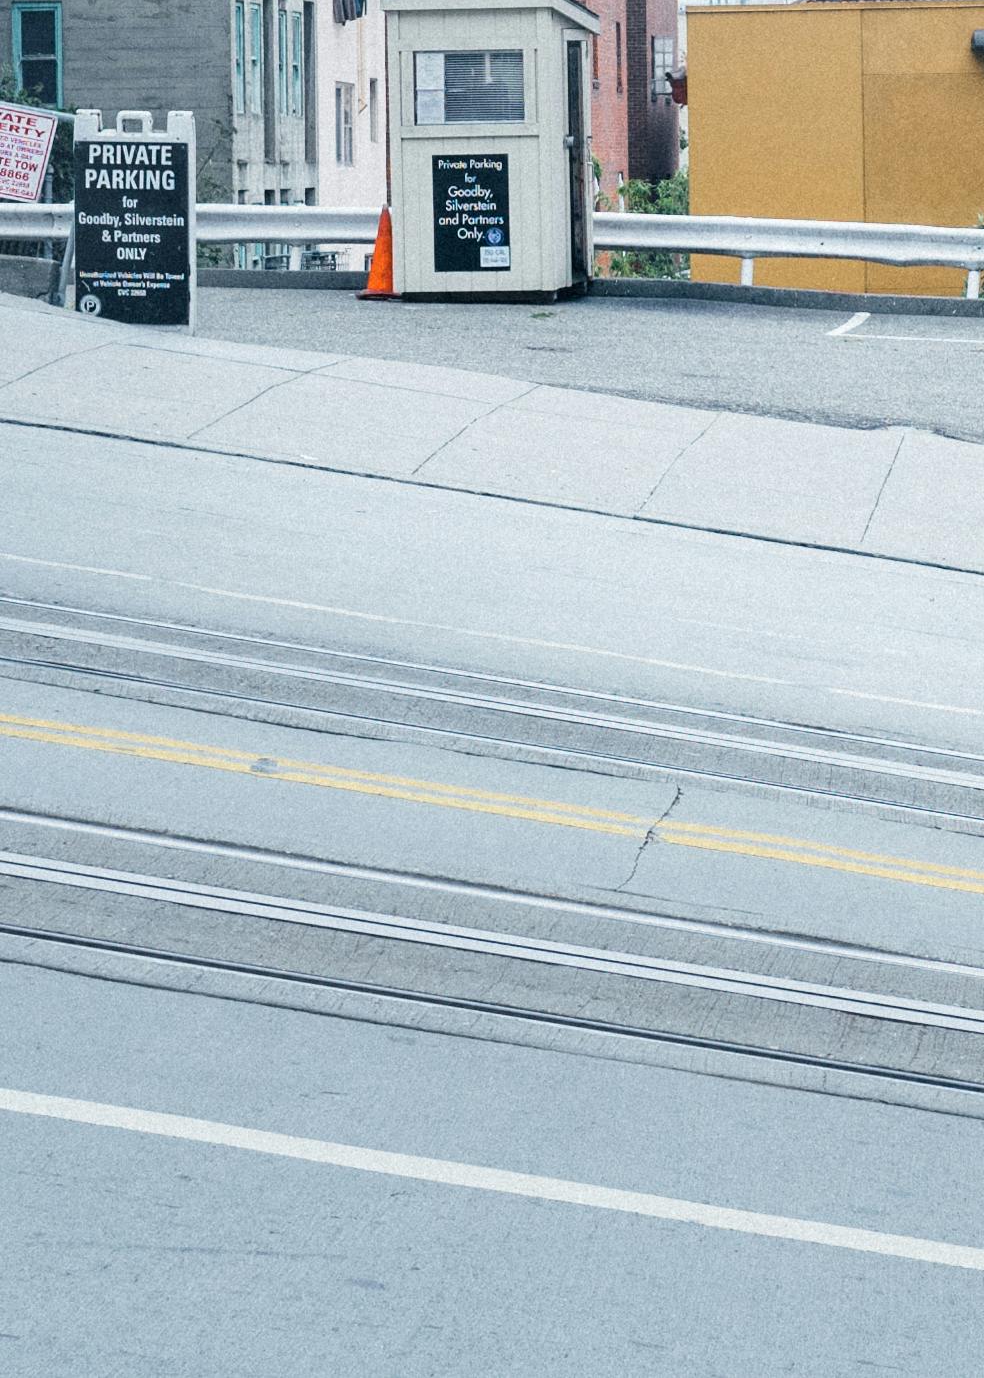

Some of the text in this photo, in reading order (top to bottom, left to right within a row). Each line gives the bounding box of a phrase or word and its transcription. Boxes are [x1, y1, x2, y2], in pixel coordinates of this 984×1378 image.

[89, 144, 173, 166] PRIVATE
[15, 160, 38, 172] TOW
[438, 159, 502, 171] Private Parking
[85, 169, 175, 190] PARKING
[464, 173, 477, 183] for
[448, 185, 493, 199] Goodby,
[122, 196, 138, 208] for
[445, 199, 497, 212] Silverstein
[78, 212, 184, 227] Goodby, Silverstein
[438, 213, 504, 225] and Partners
[102, 230, 161, 243] & Partners
[457, 227, 485, 242] Only.
[117, 247, 147, 260] ONLY
